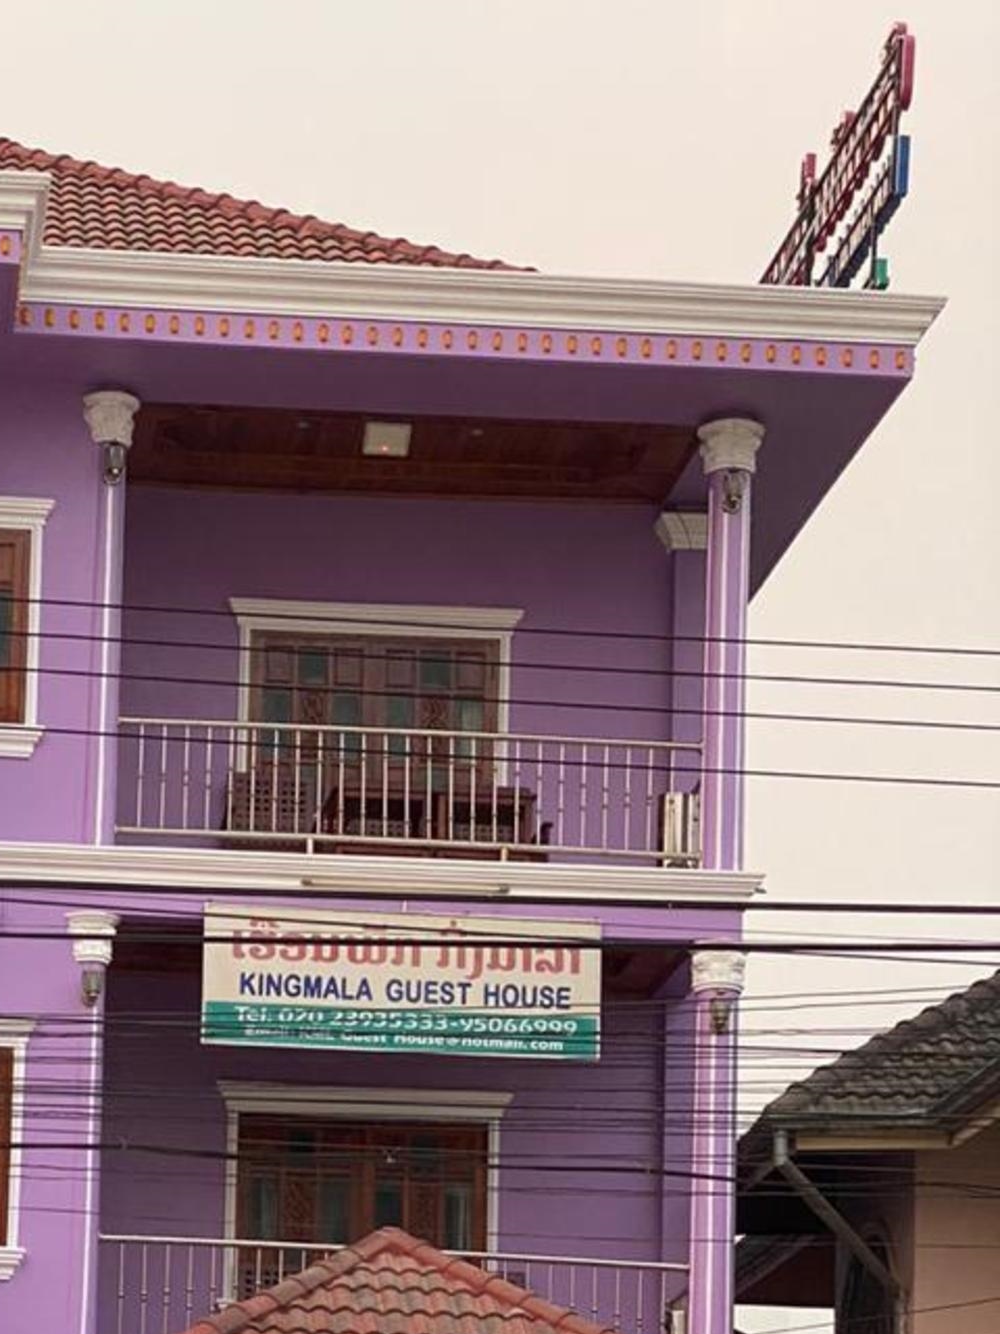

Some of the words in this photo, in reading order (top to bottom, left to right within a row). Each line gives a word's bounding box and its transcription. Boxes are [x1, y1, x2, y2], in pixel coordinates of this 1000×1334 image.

[239, 971, 373, 1001] KINGMALA
[386, 978, 473, 1006] GUEST
[484, 984, 573, 1010] HOUSE
